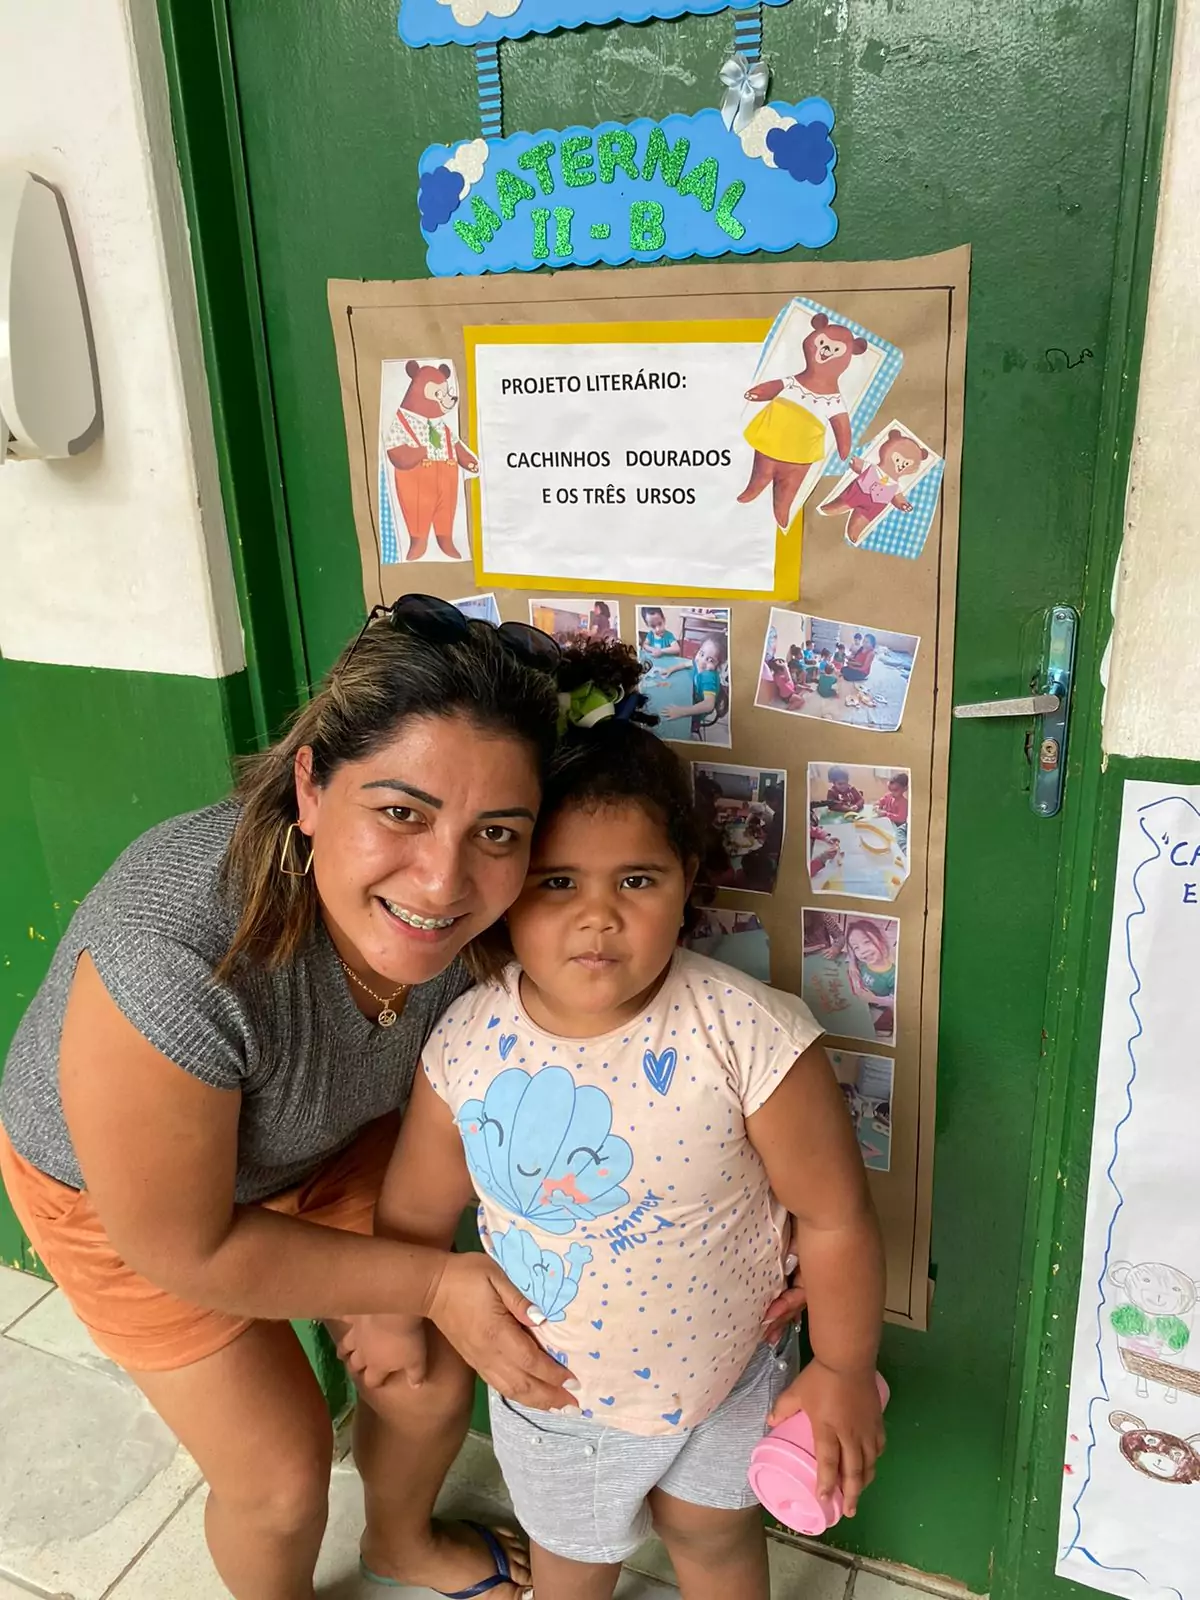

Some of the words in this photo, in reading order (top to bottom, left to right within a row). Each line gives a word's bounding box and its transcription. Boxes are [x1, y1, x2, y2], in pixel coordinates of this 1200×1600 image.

[454, 127, 746, 254] MATERNAL
[629, 200, 665, 251] B
[501, 376, 581, 394] PROJETO
[586, 369, 687, 392] LITERÁRIO:
[506, 451, 610, 468] CACHINHOS
[626, 449, 731, 467] DOURADOS
[542, 488, 551, 504] E
[556, 488, 578, 504] OS
[583, 484, 626, 504] TRÊS
[636, 488, 696, 504] URSOS
[1183, 883, 1198, 903] E
